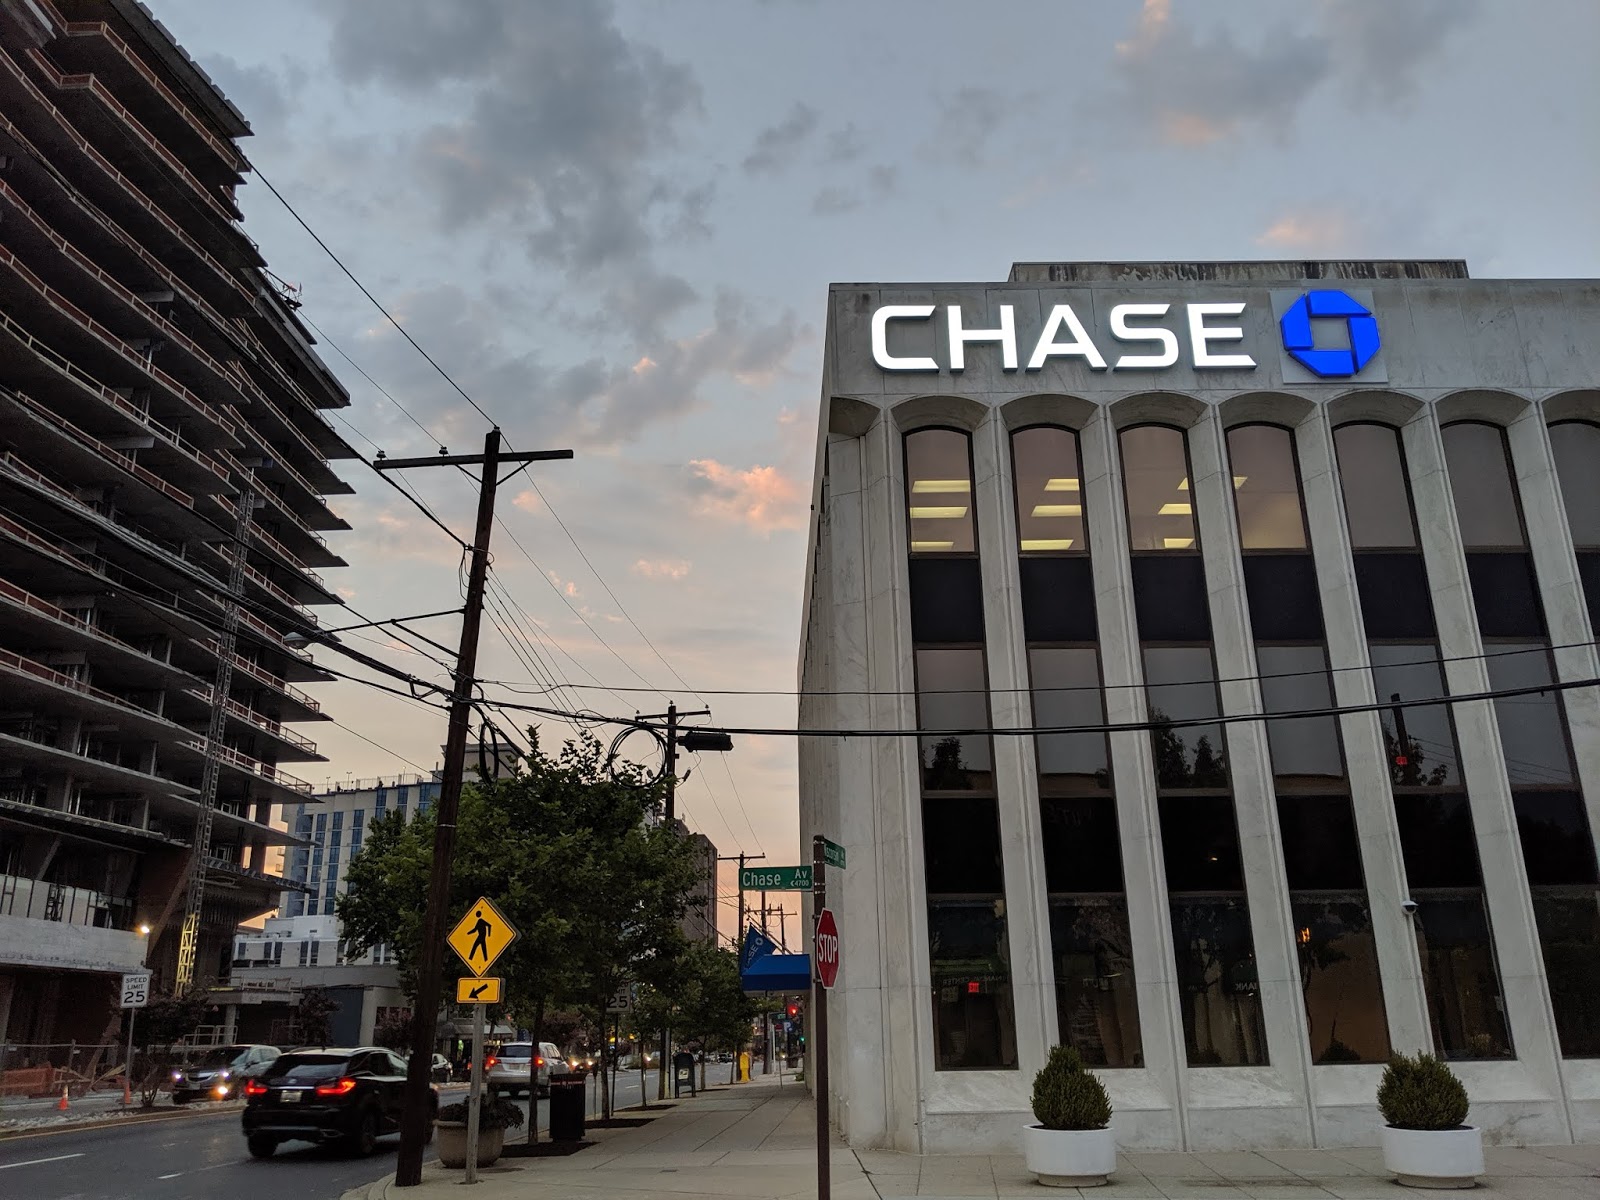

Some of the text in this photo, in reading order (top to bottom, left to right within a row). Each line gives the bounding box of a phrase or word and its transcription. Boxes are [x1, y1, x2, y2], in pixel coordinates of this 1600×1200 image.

[870, 302, 1257, 371] CHASE
[743, 868, 807, 886] Chase Av
[795, 879, 809, 887] 4700
[818, 934, 838, 963] STOP
[124, 991, 145, 1003] 25
[607, 996, 628, 1008] 25
